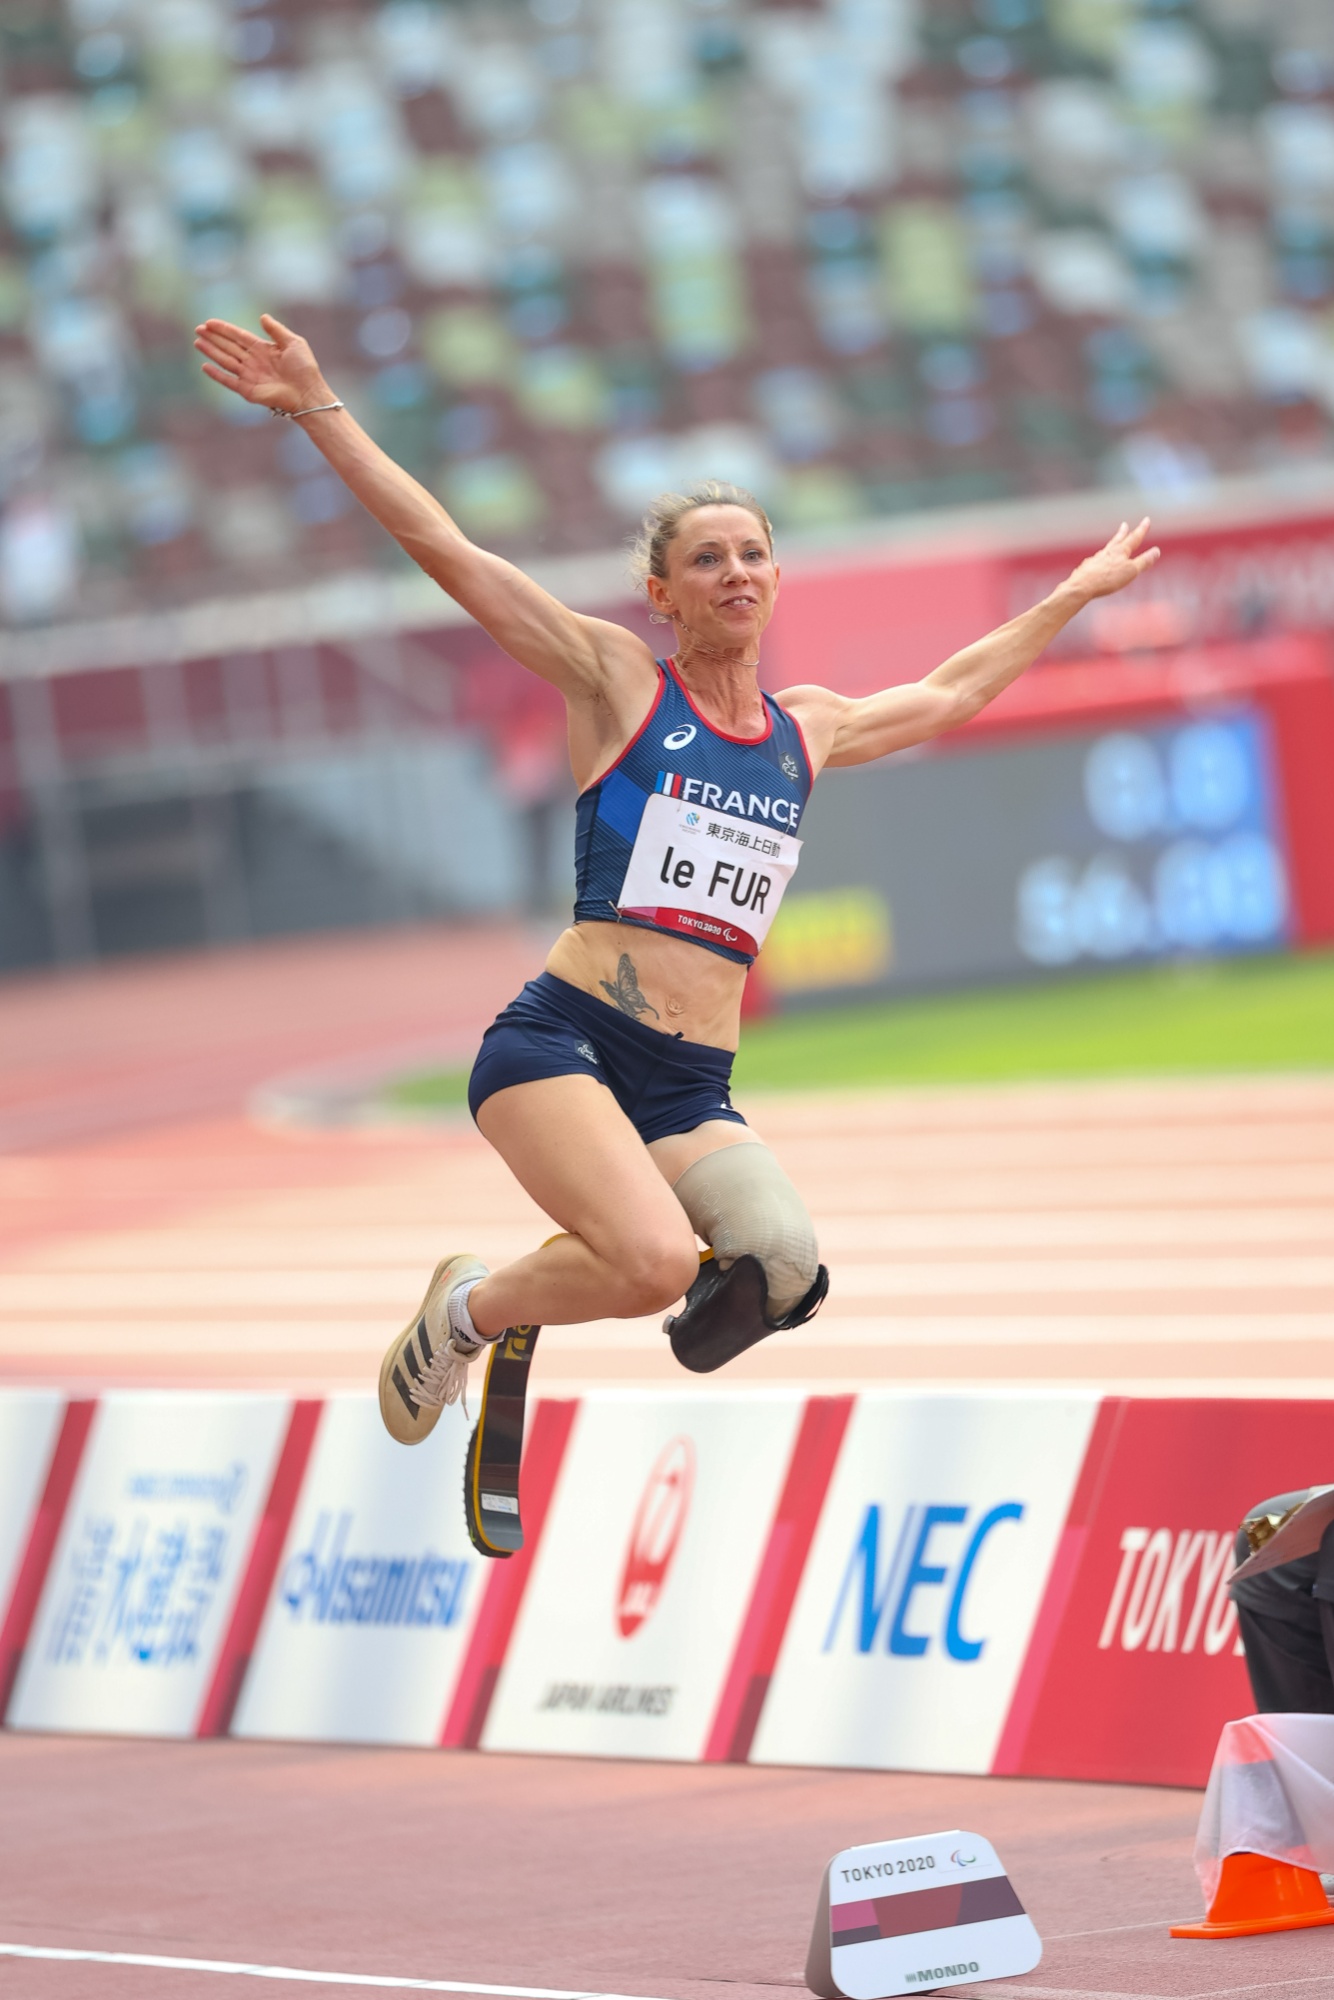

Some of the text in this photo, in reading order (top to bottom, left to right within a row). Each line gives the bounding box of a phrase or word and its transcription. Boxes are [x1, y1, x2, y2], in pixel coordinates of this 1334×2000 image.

[682, 778, 800, 827] FRANCE
[706, 822, 782, 858] 東京海上日動
[660, 846, 772, 914] le FUR
[678, 914, 703, 930] TOKYO
[824, 1503, 1026, 1662] NEC
[841, 1855, 936, 1883] TOKYO 2020
[917, 1961, 980, 1983] MONDO
